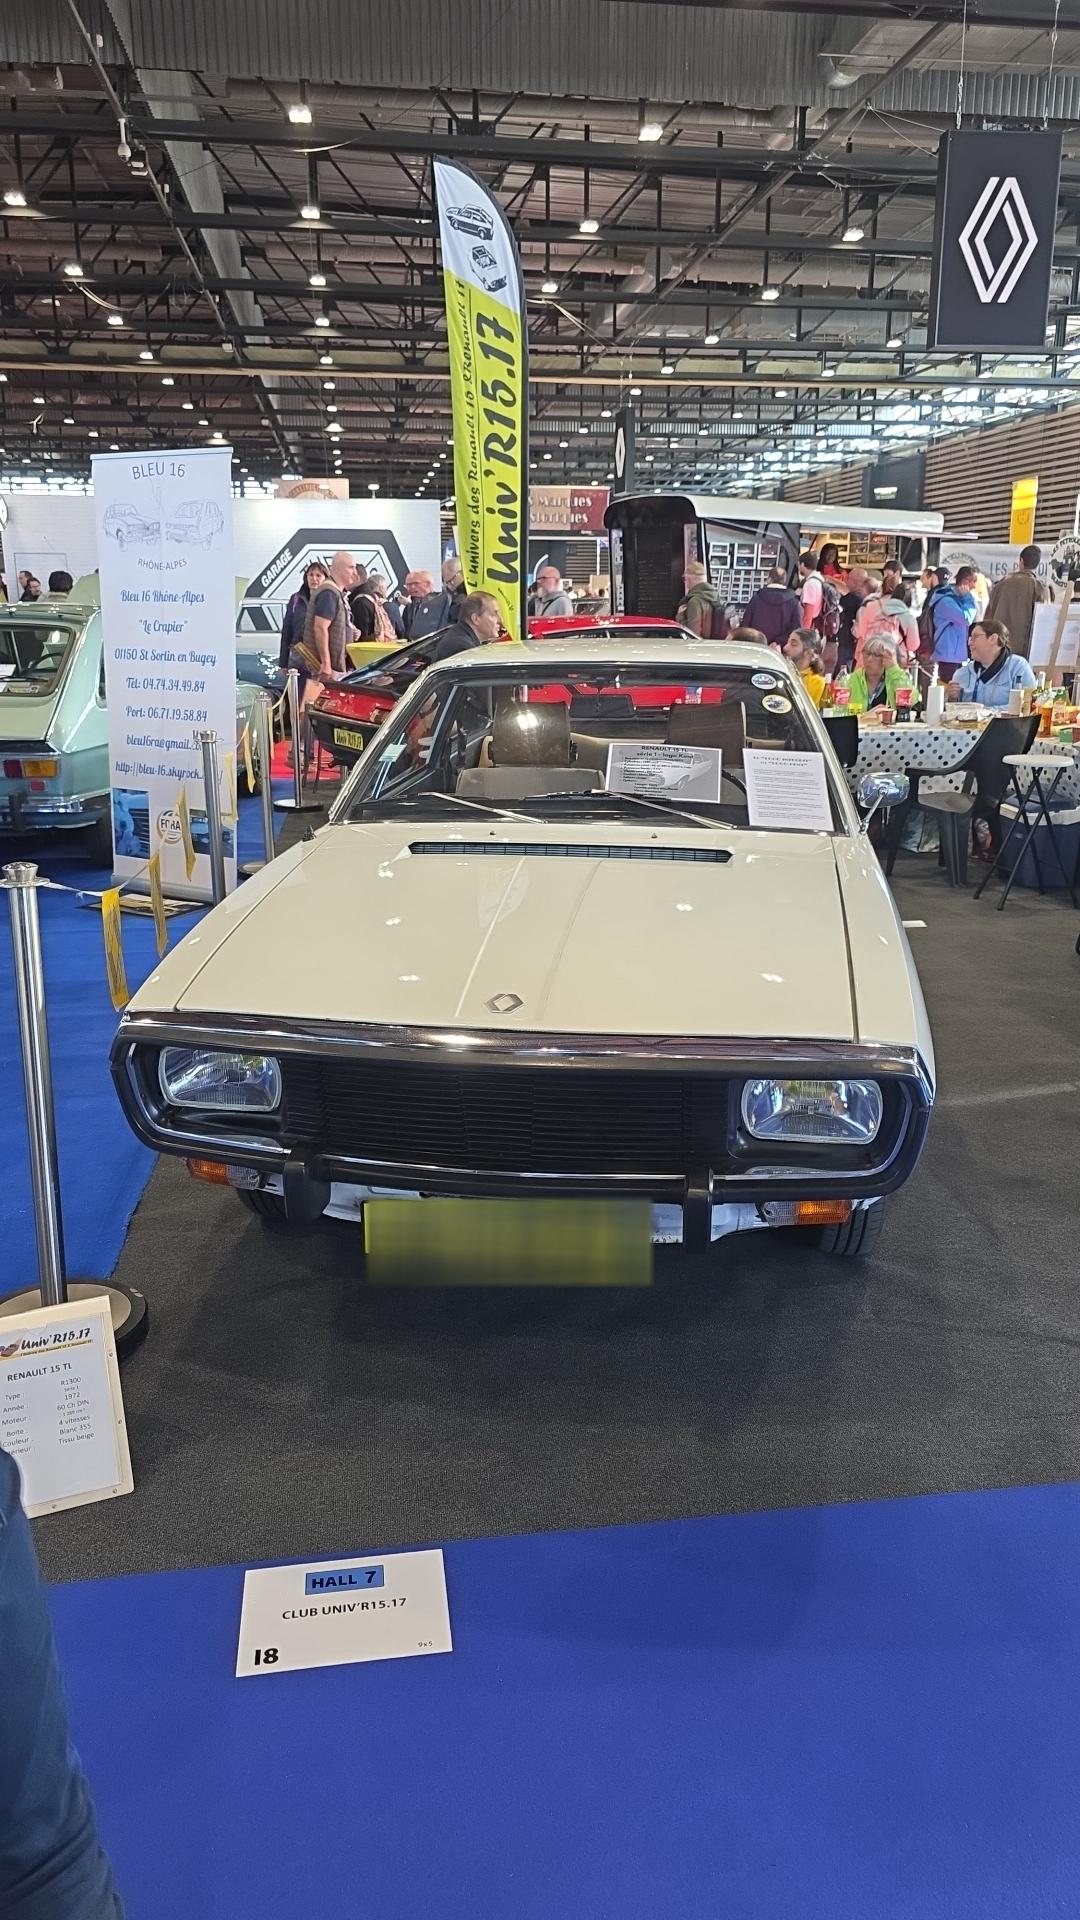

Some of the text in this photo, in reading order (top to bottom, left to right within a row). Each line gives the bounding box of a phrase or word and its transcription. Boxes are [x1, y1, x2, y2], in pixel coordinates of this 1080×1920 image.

[466, 413, 478, 481] Renault
[476, 312, 518, 584] Univ'R15.17
[132, 461, 186, 480] BLEU 16
[467, 487, 480, 514] des
[137, 557, 188, 571] RHÔNE-ALPES
[261, 548, 293, 588] GARAGE
[989, 562, 1008, 577] LES
[120, 589, 205, 606] Bleu 16 Rhône-Alpes
[114, 648, 217, 666] 01150 St Sorlin en Bugey
[142, 677, 205, 693] 04.74.34.49.84
[126, 706, 208, 722] Port: 06.71.19.58.84
[126, 734, 202, 751] bleu16ra@gmail.co
[21, 1327, 91, 1351] Univ'R15.17
[7, 1362, 72, 1382] RENAULT 15 TL
[60, 1376, 82, 1386] R1300
[5, 1393, 21, 1401] Type
[64, 1391, 81, 1401] 1972
[76, 1399, 90, 1407] DIN
[3, 1404, 24, 1413] Année
[1, 1416, 28, 1426] Moteur
[65, 1415, 90, 1425] vitesses
[59, 1427, 77, 1435] Blanc
[59, 1432, 95, 1445] Tissu beige
[2, 1438, 30, 1447] Couleur
[311, 1570, 377, 1589] HALL 7
[282, 1597, 407, 1620] CLUB UNIV'R15.17
